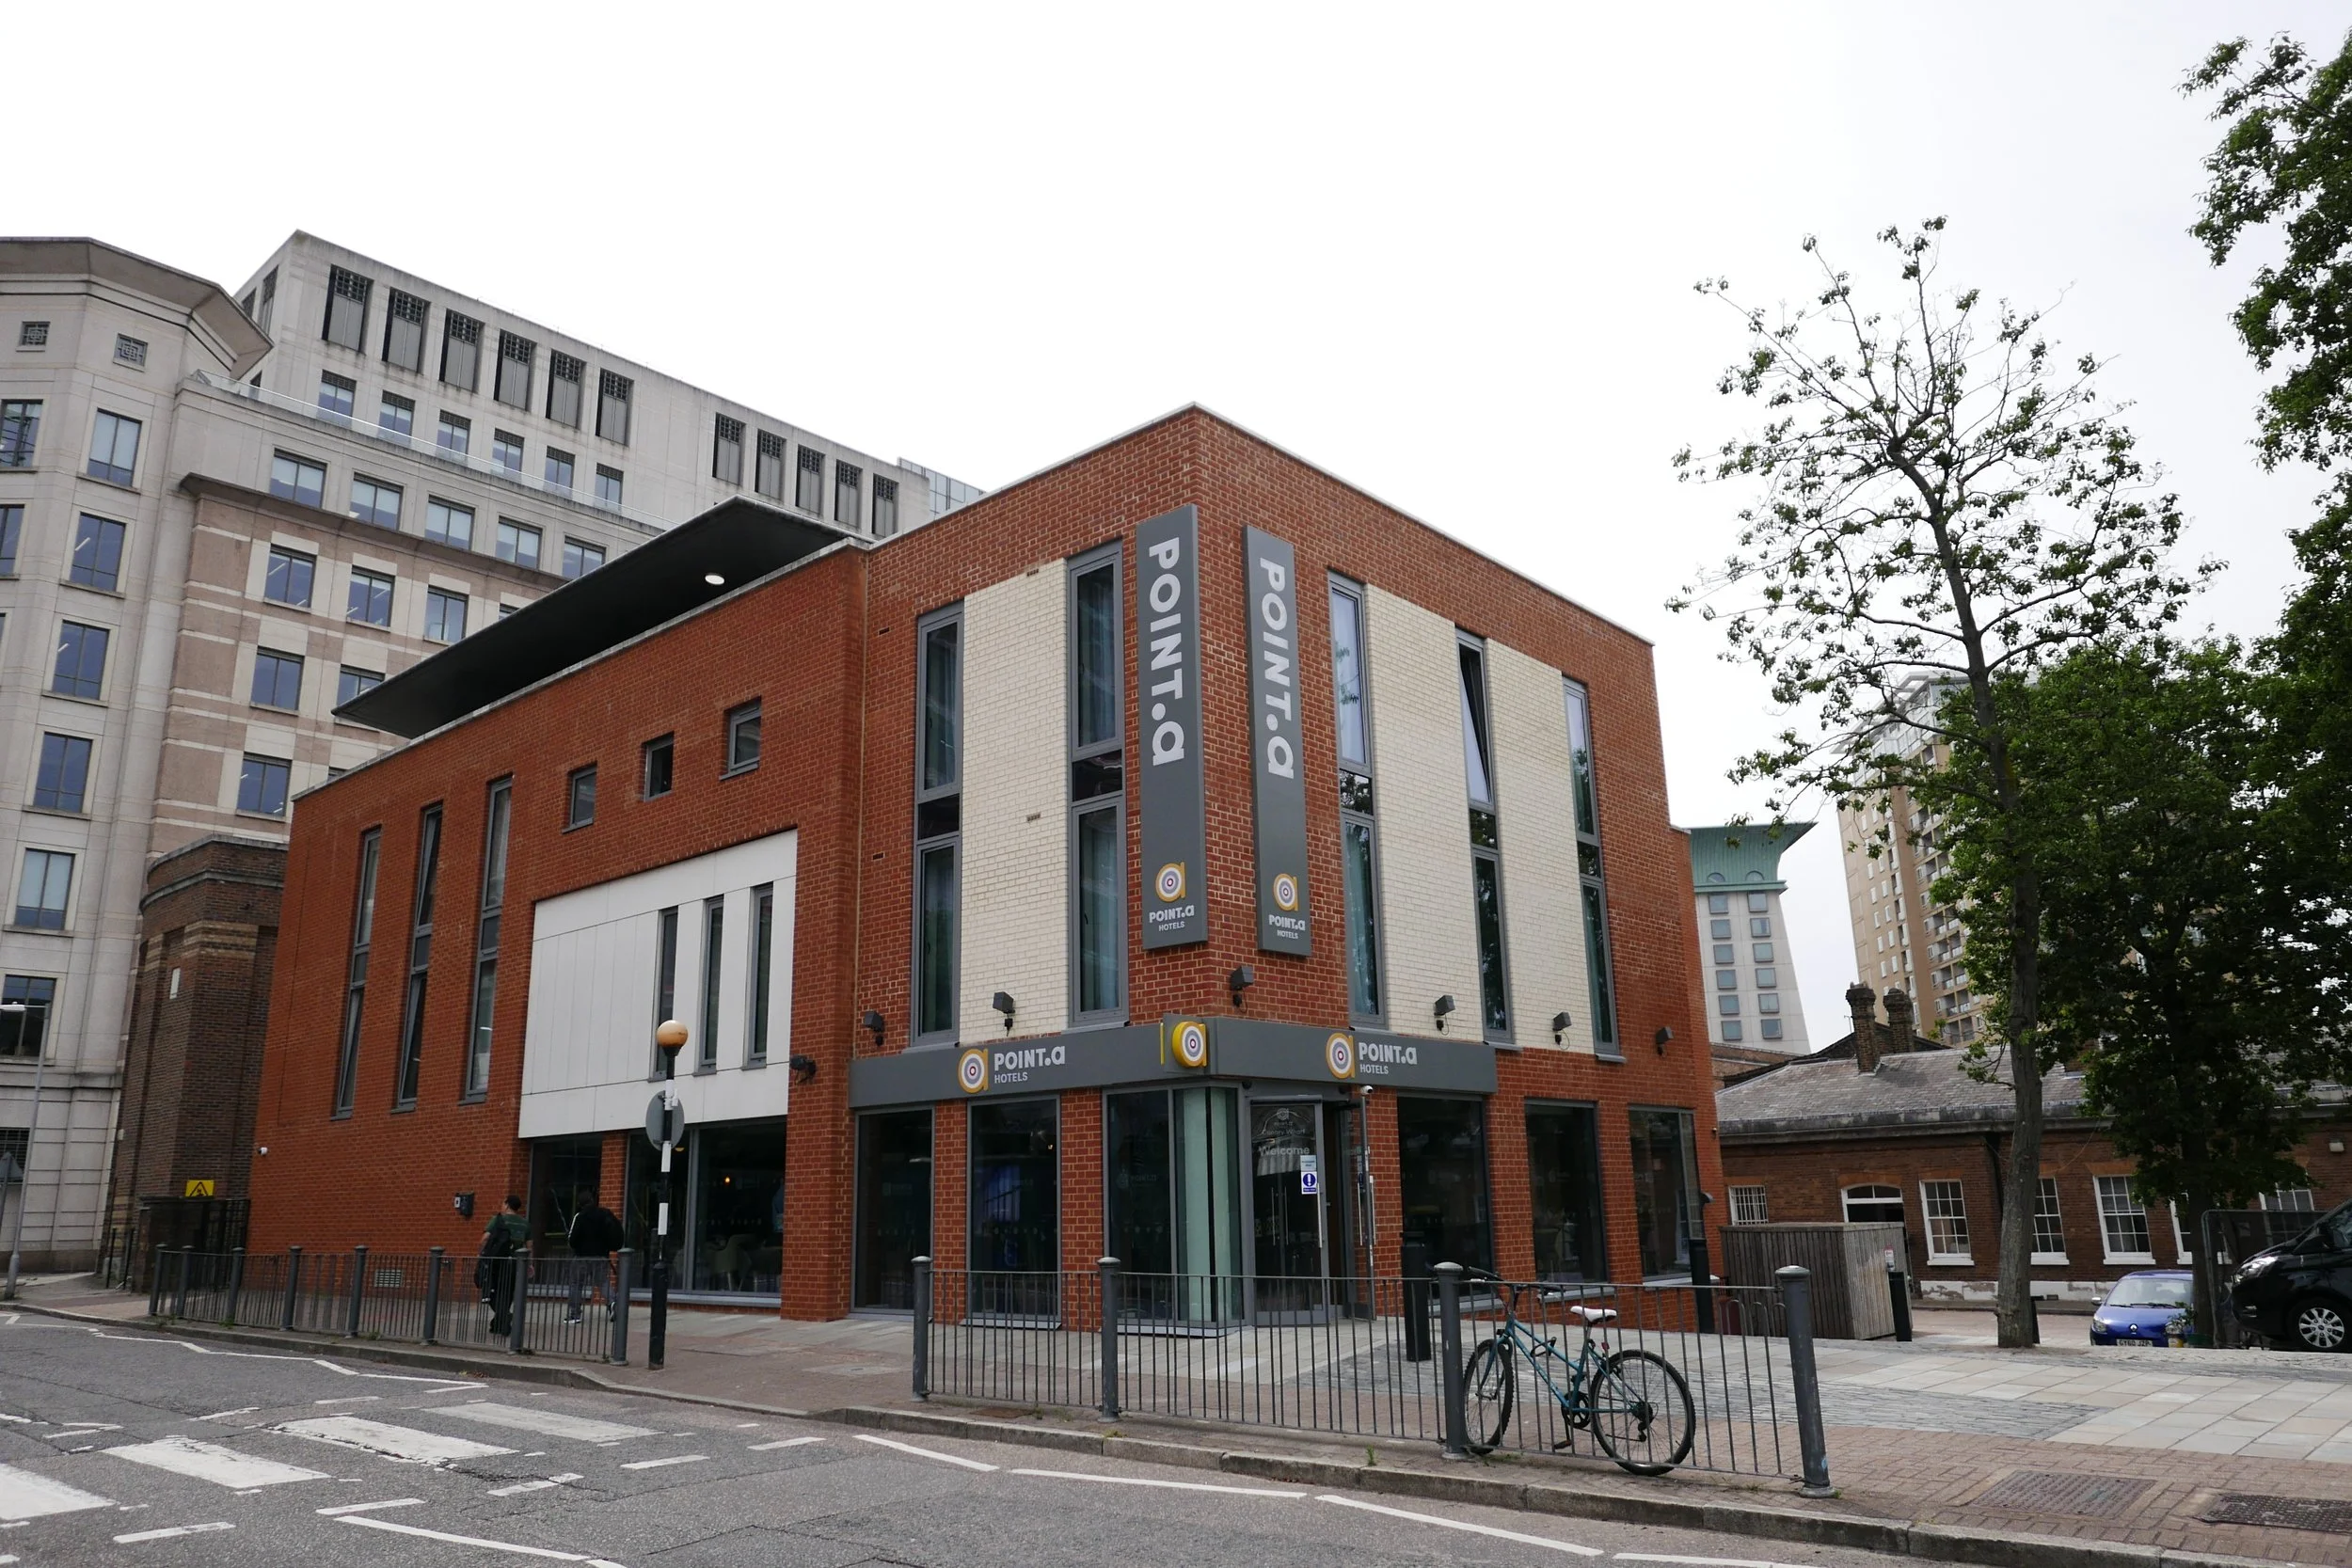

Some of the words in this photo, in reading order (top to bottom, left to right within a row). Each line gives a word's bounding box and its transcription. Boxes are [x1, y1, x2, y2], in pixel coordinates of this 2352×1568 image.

[1148, 536, 1185, 767] POINT.a
[1259, 557, 1295, 780] POINT.a
[1149, 905, 1195, 924] POINT.a
[1268, 914, 1306, 931] POINT.a
[1158, 921, 1185, 932] HOTELS
[1277, 929, 1299, 940] HOTELS
[993, 1045, 1066, 1071] POINT.a
[1358, 1042, 1418, 1065] POINT.a
[993, 1071, 1028, 1084] HOTELS
[1359, 1064, 1389, 1075] HOTELS
[1259, 1146, 1310, 1156] Welcome
